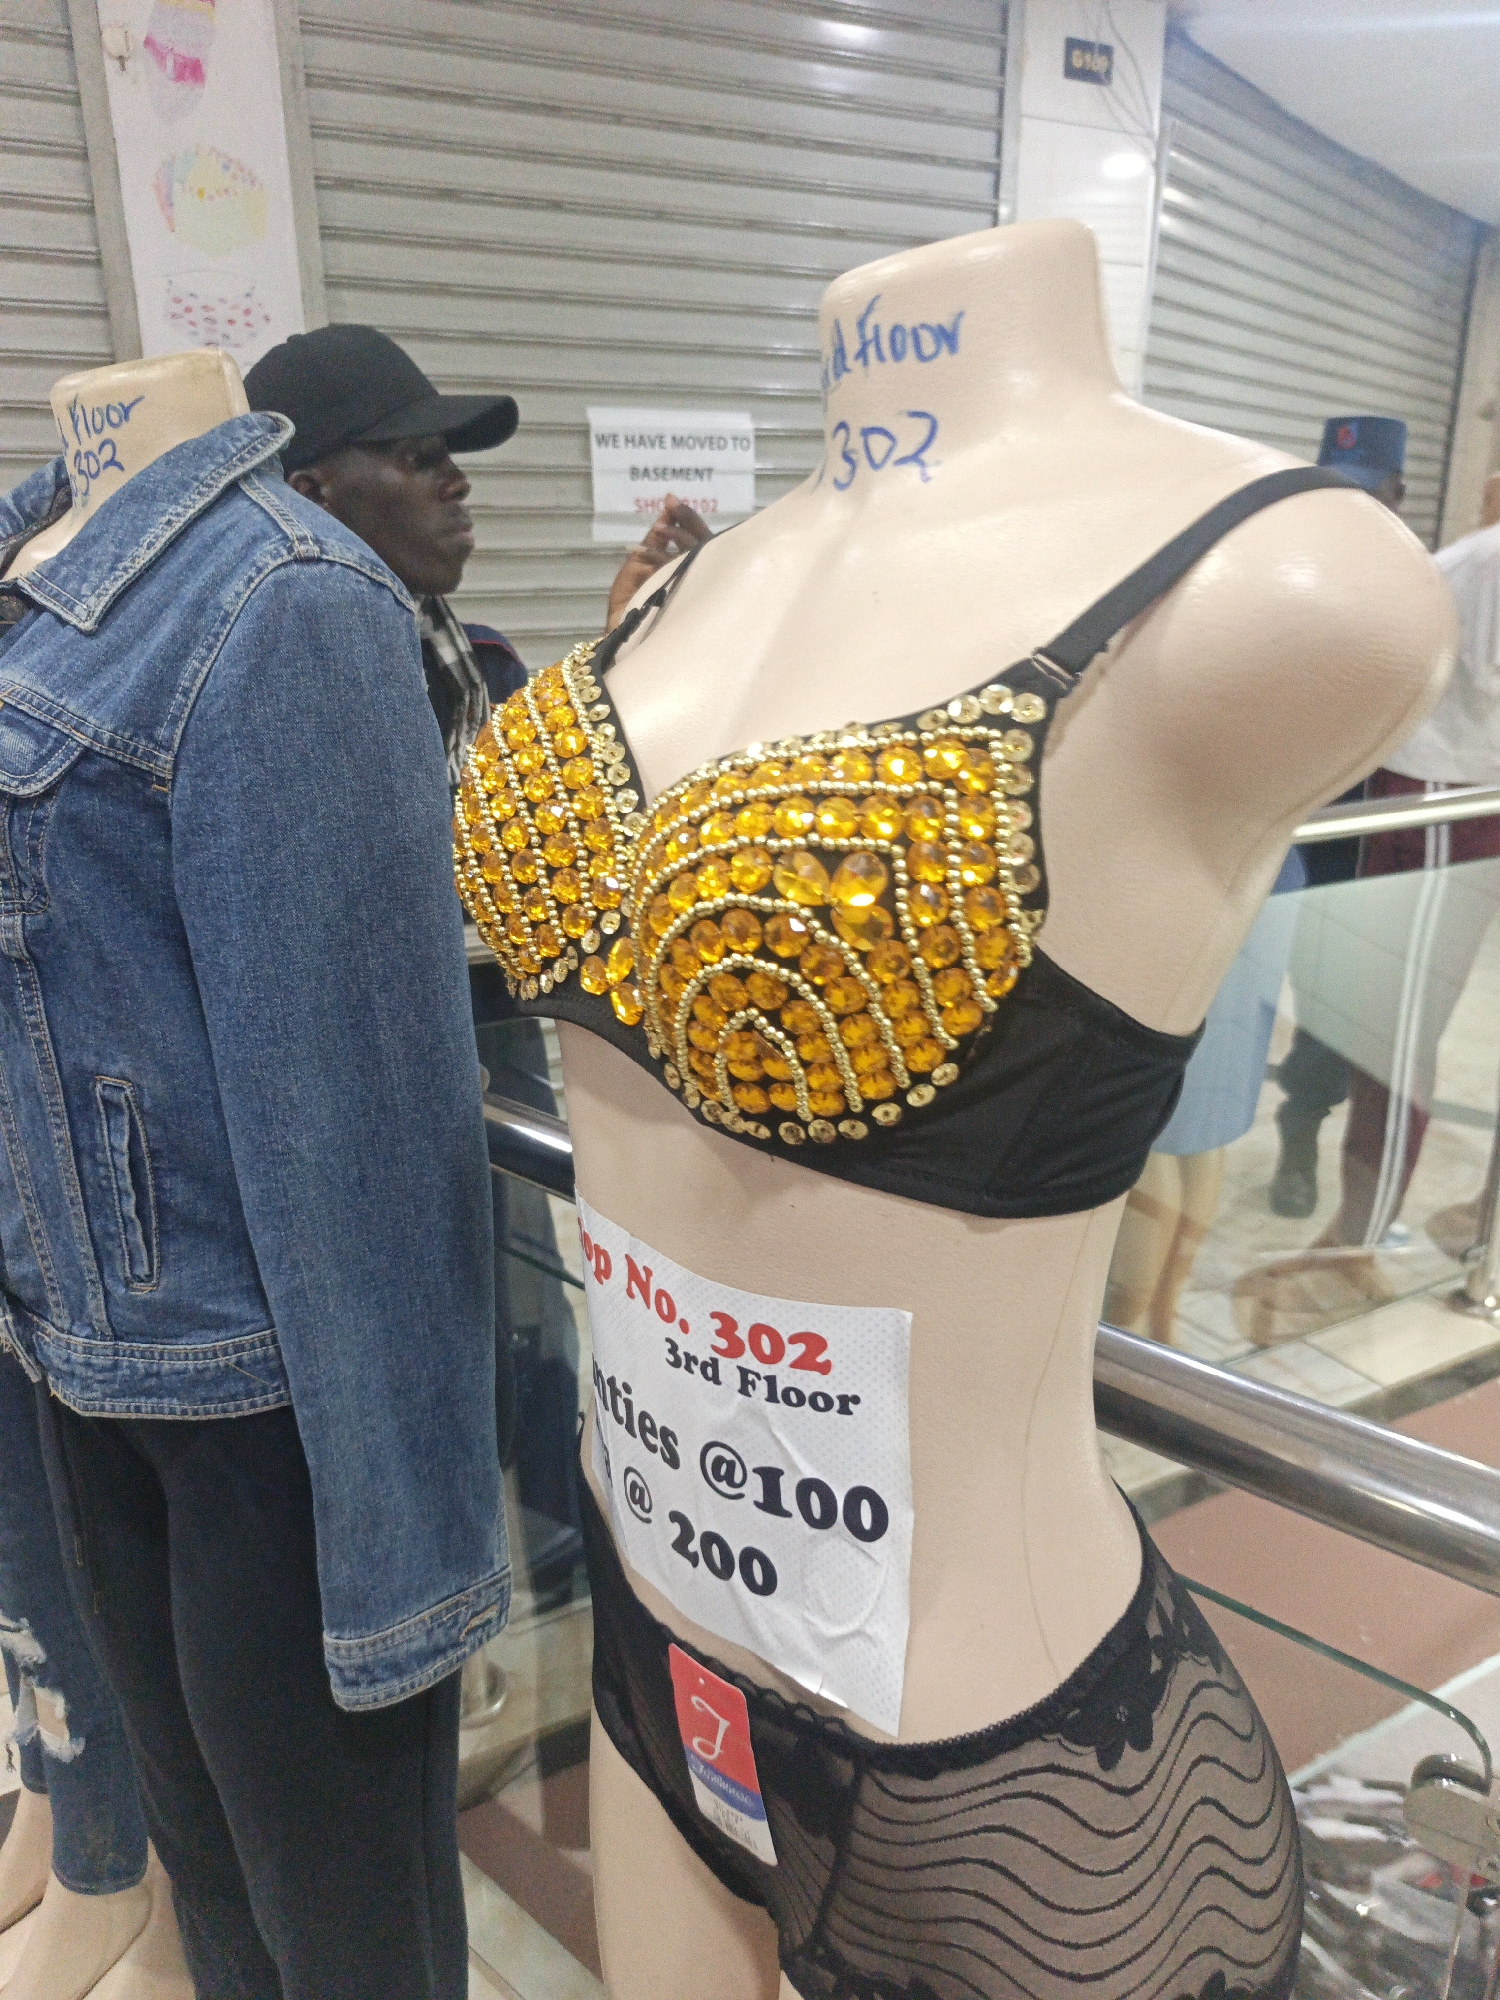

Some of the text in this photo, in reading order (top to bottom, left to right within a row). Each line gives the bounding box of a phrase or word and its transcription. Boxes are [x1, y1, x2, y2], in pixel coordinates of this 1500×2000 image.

[73, 437, 126, 497] 302
[595, 433, 751, 451] WE HAVE MOVED TO
[629, 465, 714, 482] BASEMENT
[832, 410, 940, 492] 302
[624, 1253, 690, 1335] No.
[709, 1310, 832, 1376] 302
[664, 1337, 861, 1417] 3rd Floor
[623, 1465, 778, 1597] @ 200
